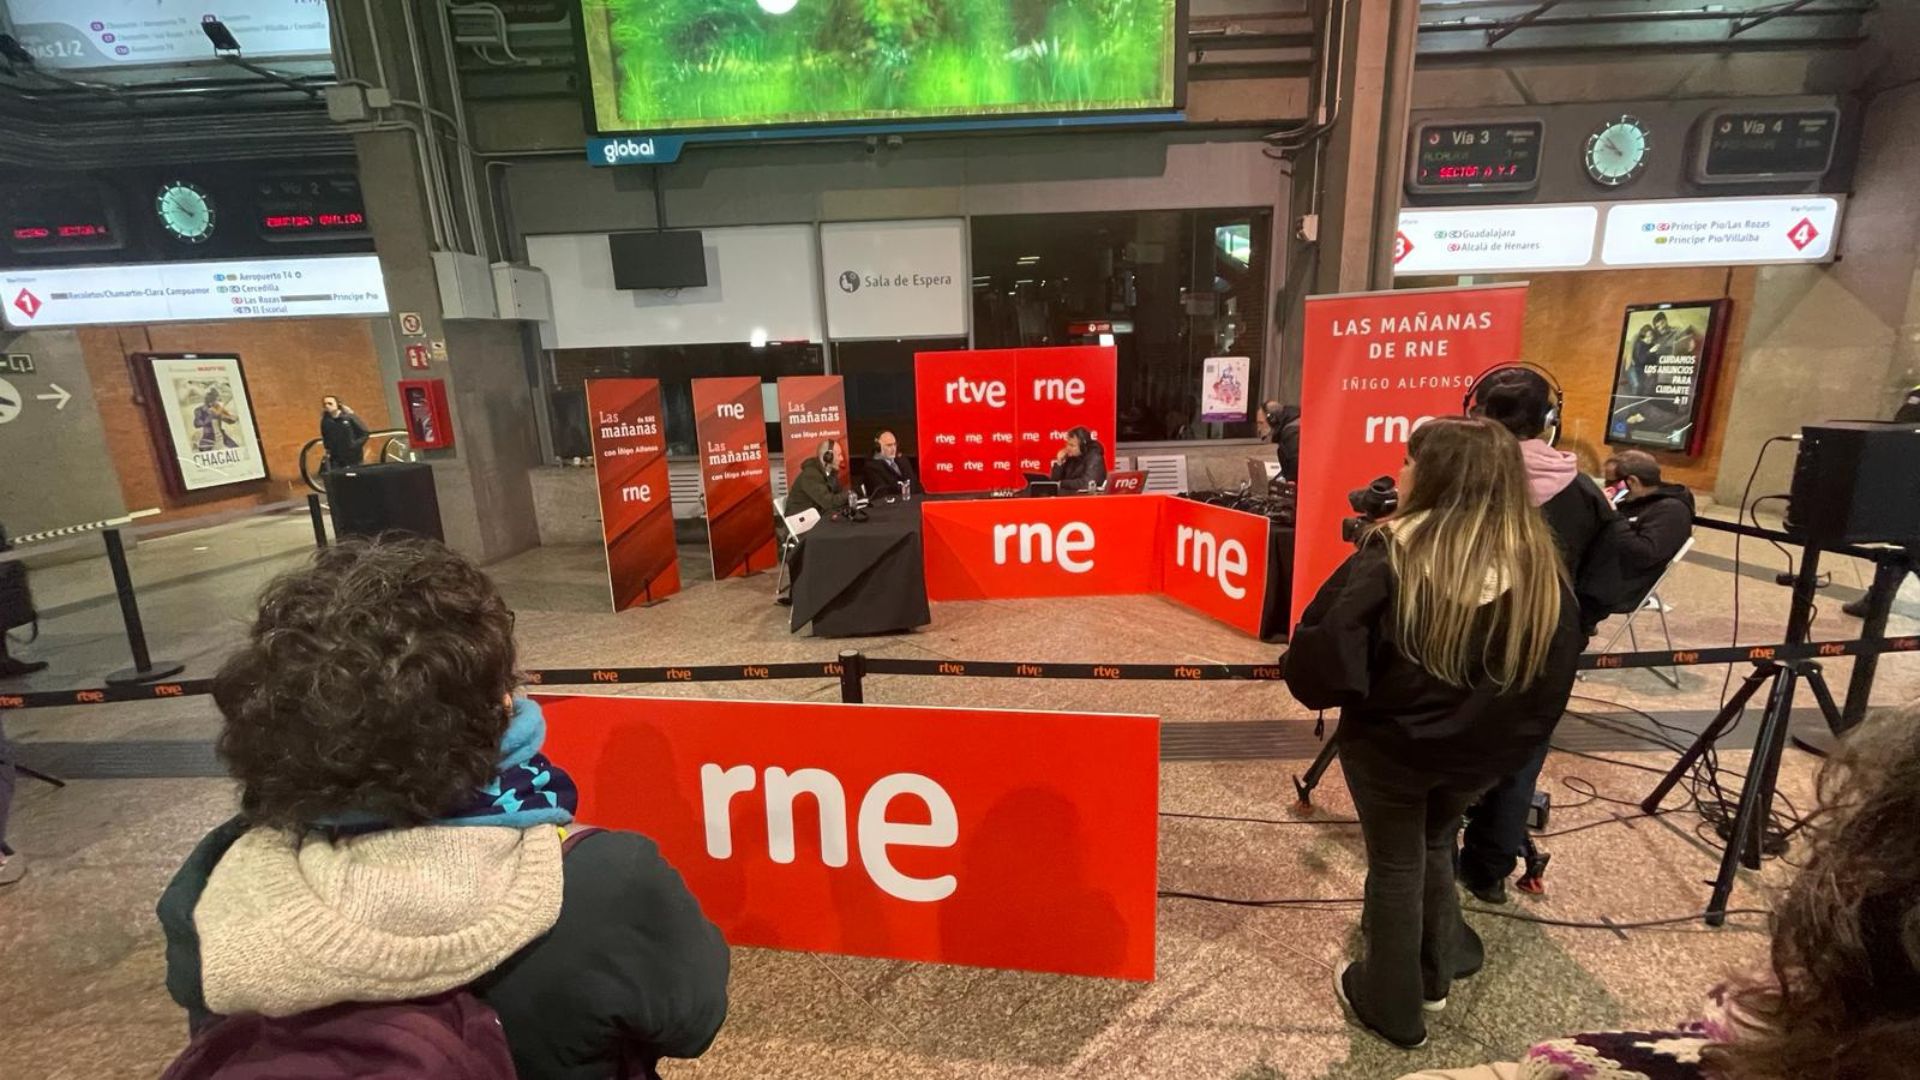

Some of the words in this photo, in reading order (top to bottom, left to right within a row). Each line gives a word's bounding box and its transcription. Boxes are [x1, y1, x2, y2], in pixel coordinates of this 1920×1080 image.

[1772, 119, 1784, 133] 4
[1480, 130, 1490, 145] 3
[604, 138, 655, 163] global
[1745, 220, 1770, 229] Rozas
[1462, 228, 1516, 240] Guadalajara
[1794, 225, 1809, 244] 4
[1490, 242, 1501, 251] de
[1504, 241, 1540, 251] Henares
[241, 284, 280, 293] Cercedilla
[864, 273, 890, 288] Sala
[895, 273, 910, 287] de
[913, 273, 952, 289] Espera
[23, 294, 34, 313] 1
[1332, 317, 1372, 337] LAS
[1380, 311, 1493, 334] MAÑANAS
[1368, 342, 1396, 360] DE
[1404, 340, 1449, 359] RNE
[1658, 355, 1696, 365] CUIDAMOS
[1644, 364, 1657, 373] LOS
[1657, 365, 1694, 375] ANUNCIOS
[1397, 374, 1474, 389] ALFONSO
[1672, 375, 1692, 385] PARA
[945, 376, 1007, 408] rtve
[1033, 376, 1086, 406] rne
[1655, 385, 1691, 395] CUIDARTE
[717, 402, 745, 420] rne
[788, 401, 806, 412] Las
[599, 411, 619, 424] Las
[789, 411, 840, 425] mañanas
[601, 422, 658, 439] mañanas
[935, 433, 956, 444] rtve
[965, 433, 983, 444] rne
[992, 432, 1013, 443] rtve
[1022, 431, 1040, 442] rne
[604, 449, 617, 457] con
[707, 441, 726, 453] Las
[709, 450, 762, 466] mañanas
[936, 462, 954, 473] rne
[964, 460, 984, 471] rtve
[993, 460, 1011, 470] rne
[1020, 459, 1041, 470] rtve
[1114, 476, 1139, 490] rne
[622, 484, 652, 503] rne
[992, 520, 1096, 574] rne
[1176, 523, 1249, 601] rne
[1596, 655, 1622, 668] rtve
[1672, 650, 1700, 664] rtve
[1750, 647, 1776, 660] rtve
[1820, 643, 1846, 657] rtve
[592, 669, 619, 682] rtve
[666, 667, 692, 681] rtve
[743, 665, 769, 679] rtve
[823, 663, 844, 676] rtv
[939, 662, 965, 676] rtve
[1016, 663, 1043, 678] rtve
[1093, 665, 1121, 679] rtve
[1174, 665, 1201, 679] rtve
[1253, 665, 1281, 679] rtve
[155, 683, 184, 696] rtve
[699, 762, 960, 902] rne
